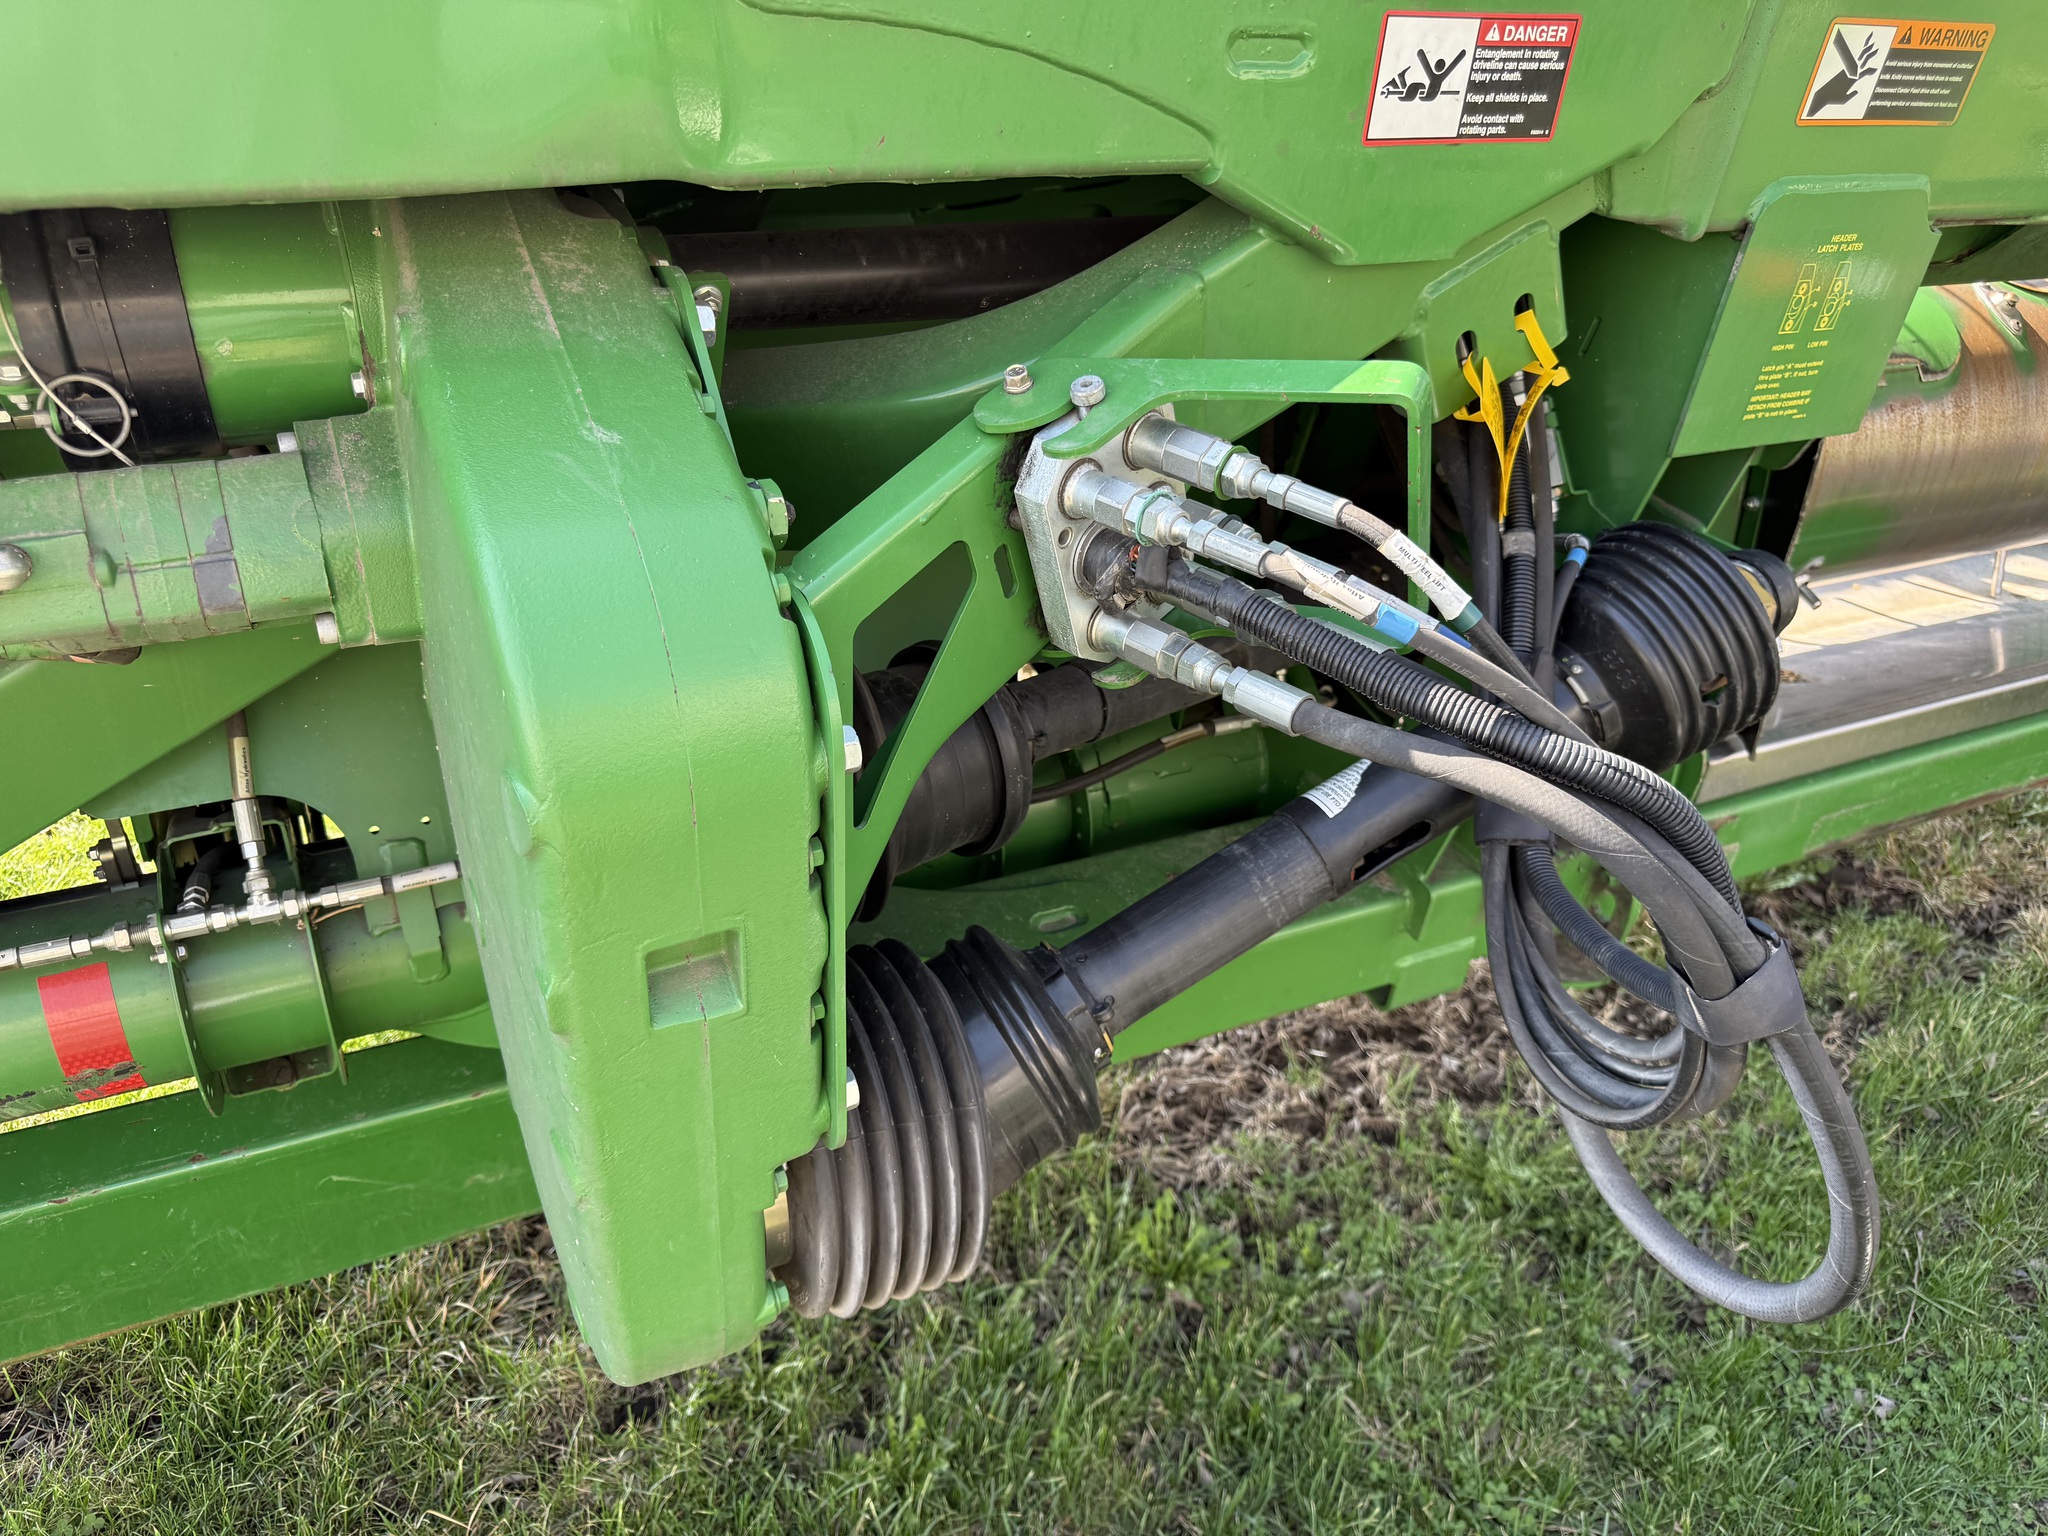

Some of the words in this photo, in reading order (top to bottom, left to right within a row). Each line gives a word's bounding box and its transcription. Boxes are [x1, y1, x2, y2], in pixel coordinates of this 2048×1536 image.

[1503, 25, 1568, 42] DANGER
[1919, 28, 1989, 48] WARNING
[1475, 49, 1523, 61] Entanglement
[1524, 49, 1531, 59] in
[1532, 50, 1559, 61] rotating
[1473, 60, 1503, 70] driveline
[1504, 61, 1517, 70] can
[1518, 61, 1539, 70] cause
[1539, 61, 1565, 70] serious
[1470, 71, 1491, 83] injury
[1492, 73, 1500, 81] or
[1500, 71, 1522, 81] death.
[1466, 92, 1484, 104] Keep
[1485, 92, 1494, 103] all
[1495, 92, 1520, 103] shields
[1521, 93, 1528, 103] in
[1528, 93, 1548, 105] place.
[1461, 114, 1483, 124] Avoid
[1483, 114, 1509, 124] contact
[1509, 114, 1524, 124] with
[1459, 125, 1486, 136] rotating
[1487, 125, 1507, 136] parts.
[1831, 234, 1858, 243] HEADER
[1817, 244, 1839, 253] LATCH
[1840, 243, 1863, 251] PLATES
[1771, 344, 1785, 352] HIGH
[1785, 343, 1795, 351] PIN
[1807, 341, 1819, 349] LOW
[1819, 340, 1829, 348] PIN
[1398, 546, 1419, 565] MULTI
[1432, 577, 1446, 591] LIFT
